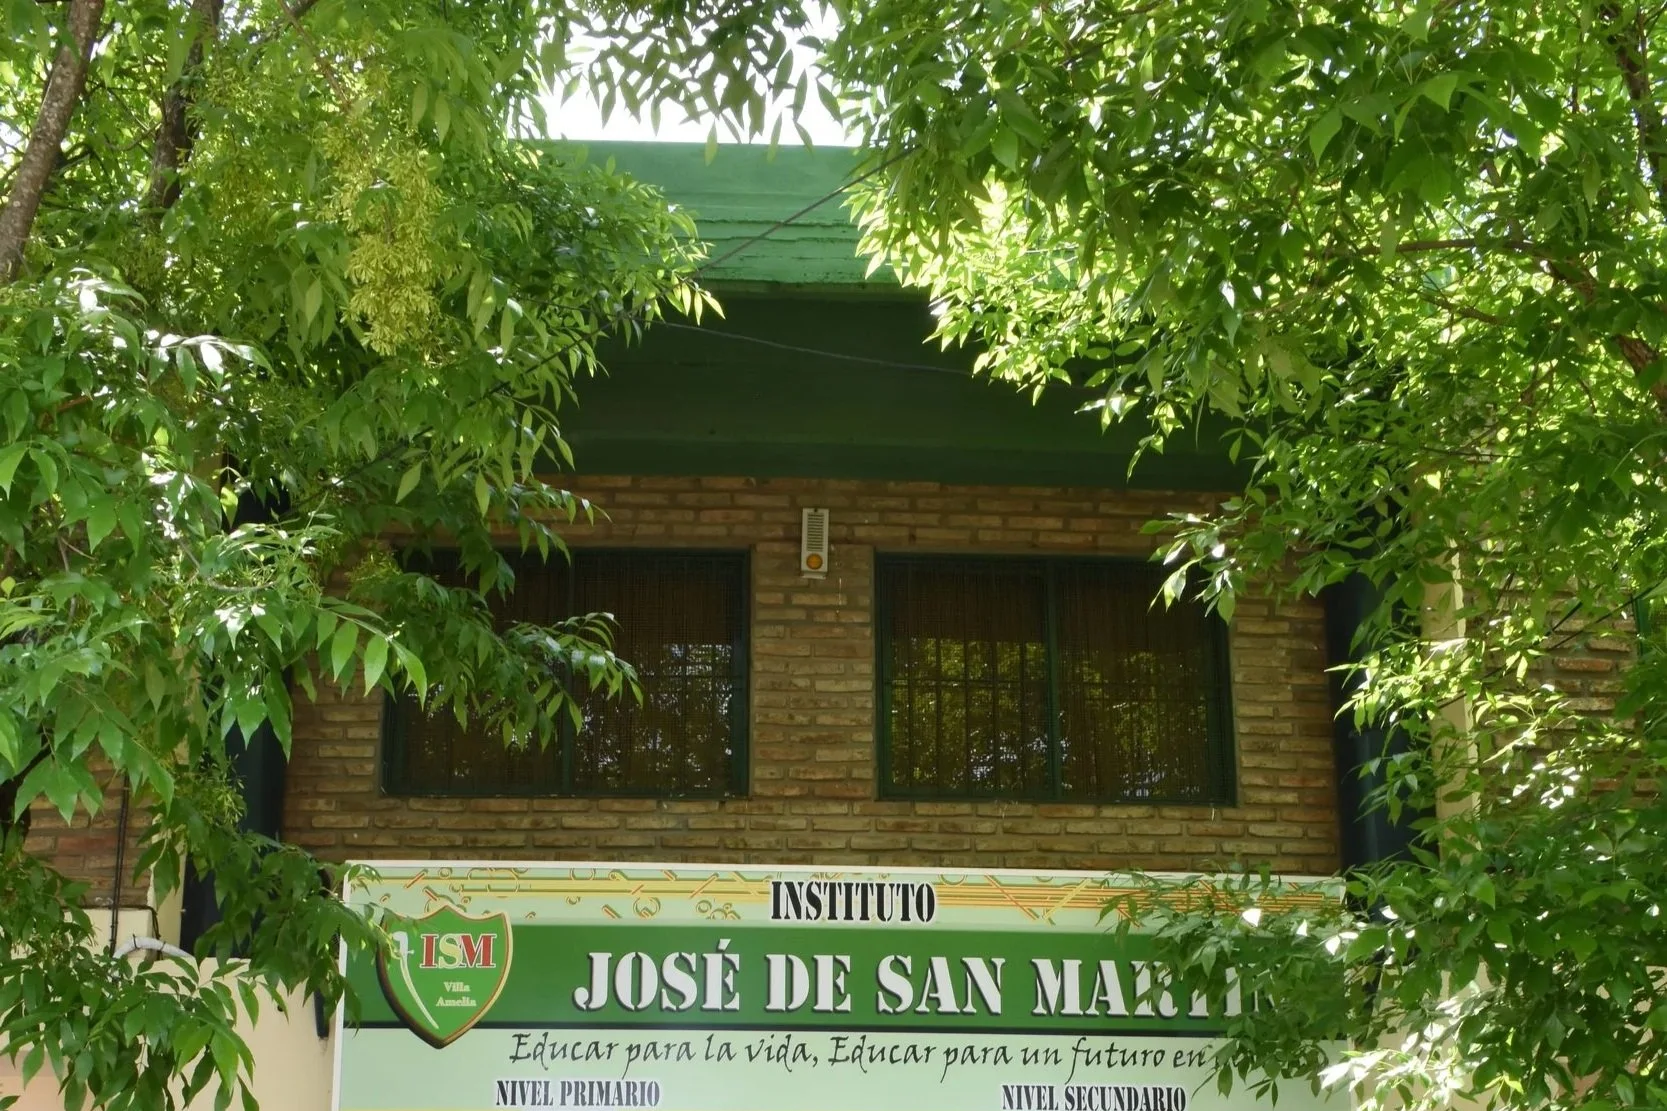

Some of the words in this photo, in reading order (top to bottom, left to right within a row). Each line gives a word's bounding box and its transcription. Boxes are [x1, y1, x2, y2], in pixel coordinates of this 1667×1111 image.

[771, 881, 935, 922] INSTITUTO
[420, 933, 497, 969] ISM
[443, 981, 471, 992] Villa
[573, 938, 740, 1011] JOSÉ
[764, 954, 851, 1012] DE
[877, 955, 1006, 1014] SAN
[436, 996, 477, 1007] Amelia
[509, 1032, 619, 1071] Educar
[621, 1041, 696, 1080] para
[704, 1032, 736, 1063] la
[744, 1033, 819, 1072] vida,
[828, 1035, 936, 1073] Educar
[940, 1042, 1013, 1083] para
[1020, 1044, 1062, 1066] un
[1065, 1036, 1166, 1084] futuro
[1173, 1049, 1207, 1068] en
[496, 1080, 554, 1106] NIVEL
[559, 1081, 660, 1107] PRIMARIO
[1002, 1085, 1059, 1111] NIVEL
